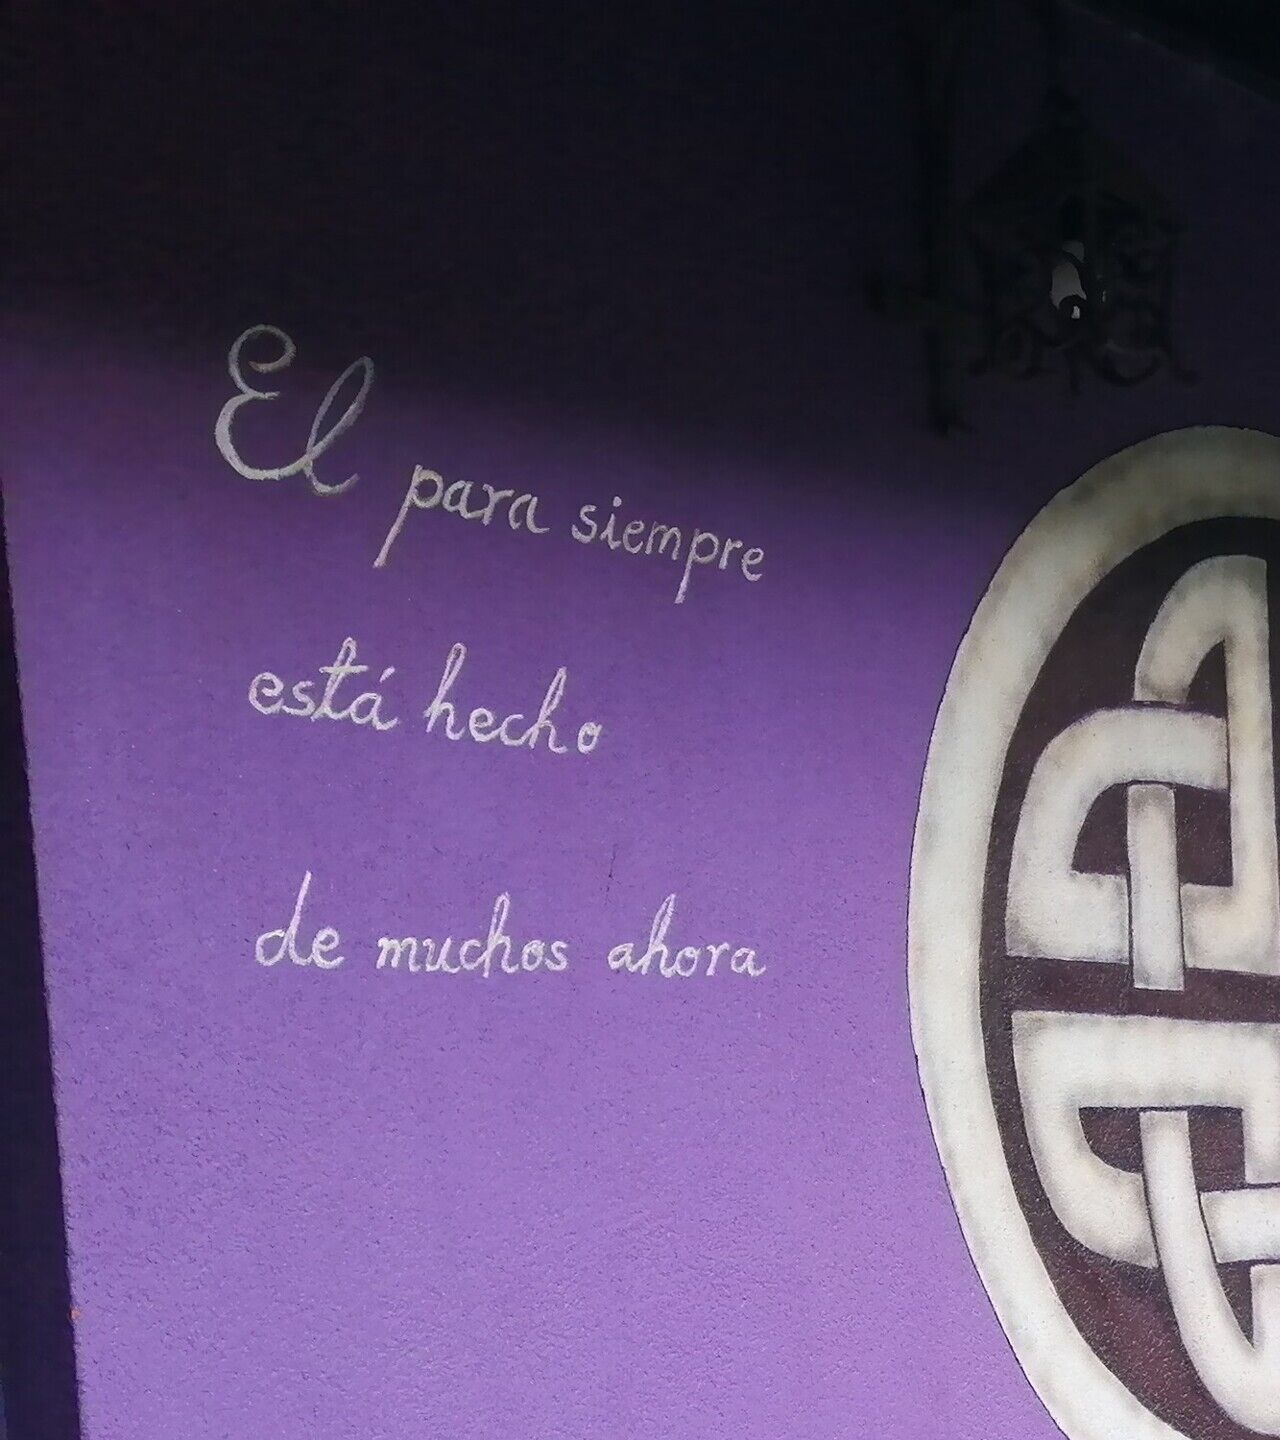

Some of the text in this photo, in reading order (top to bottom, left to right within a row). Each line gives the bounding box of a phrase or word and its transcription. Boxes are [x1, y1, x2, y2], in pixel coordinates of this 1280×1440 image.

[214, 324, 765, 604] El para siempre
[248, 637, 602, 754] está hecho
[255, 871, 766, 977] de muchos ahora
